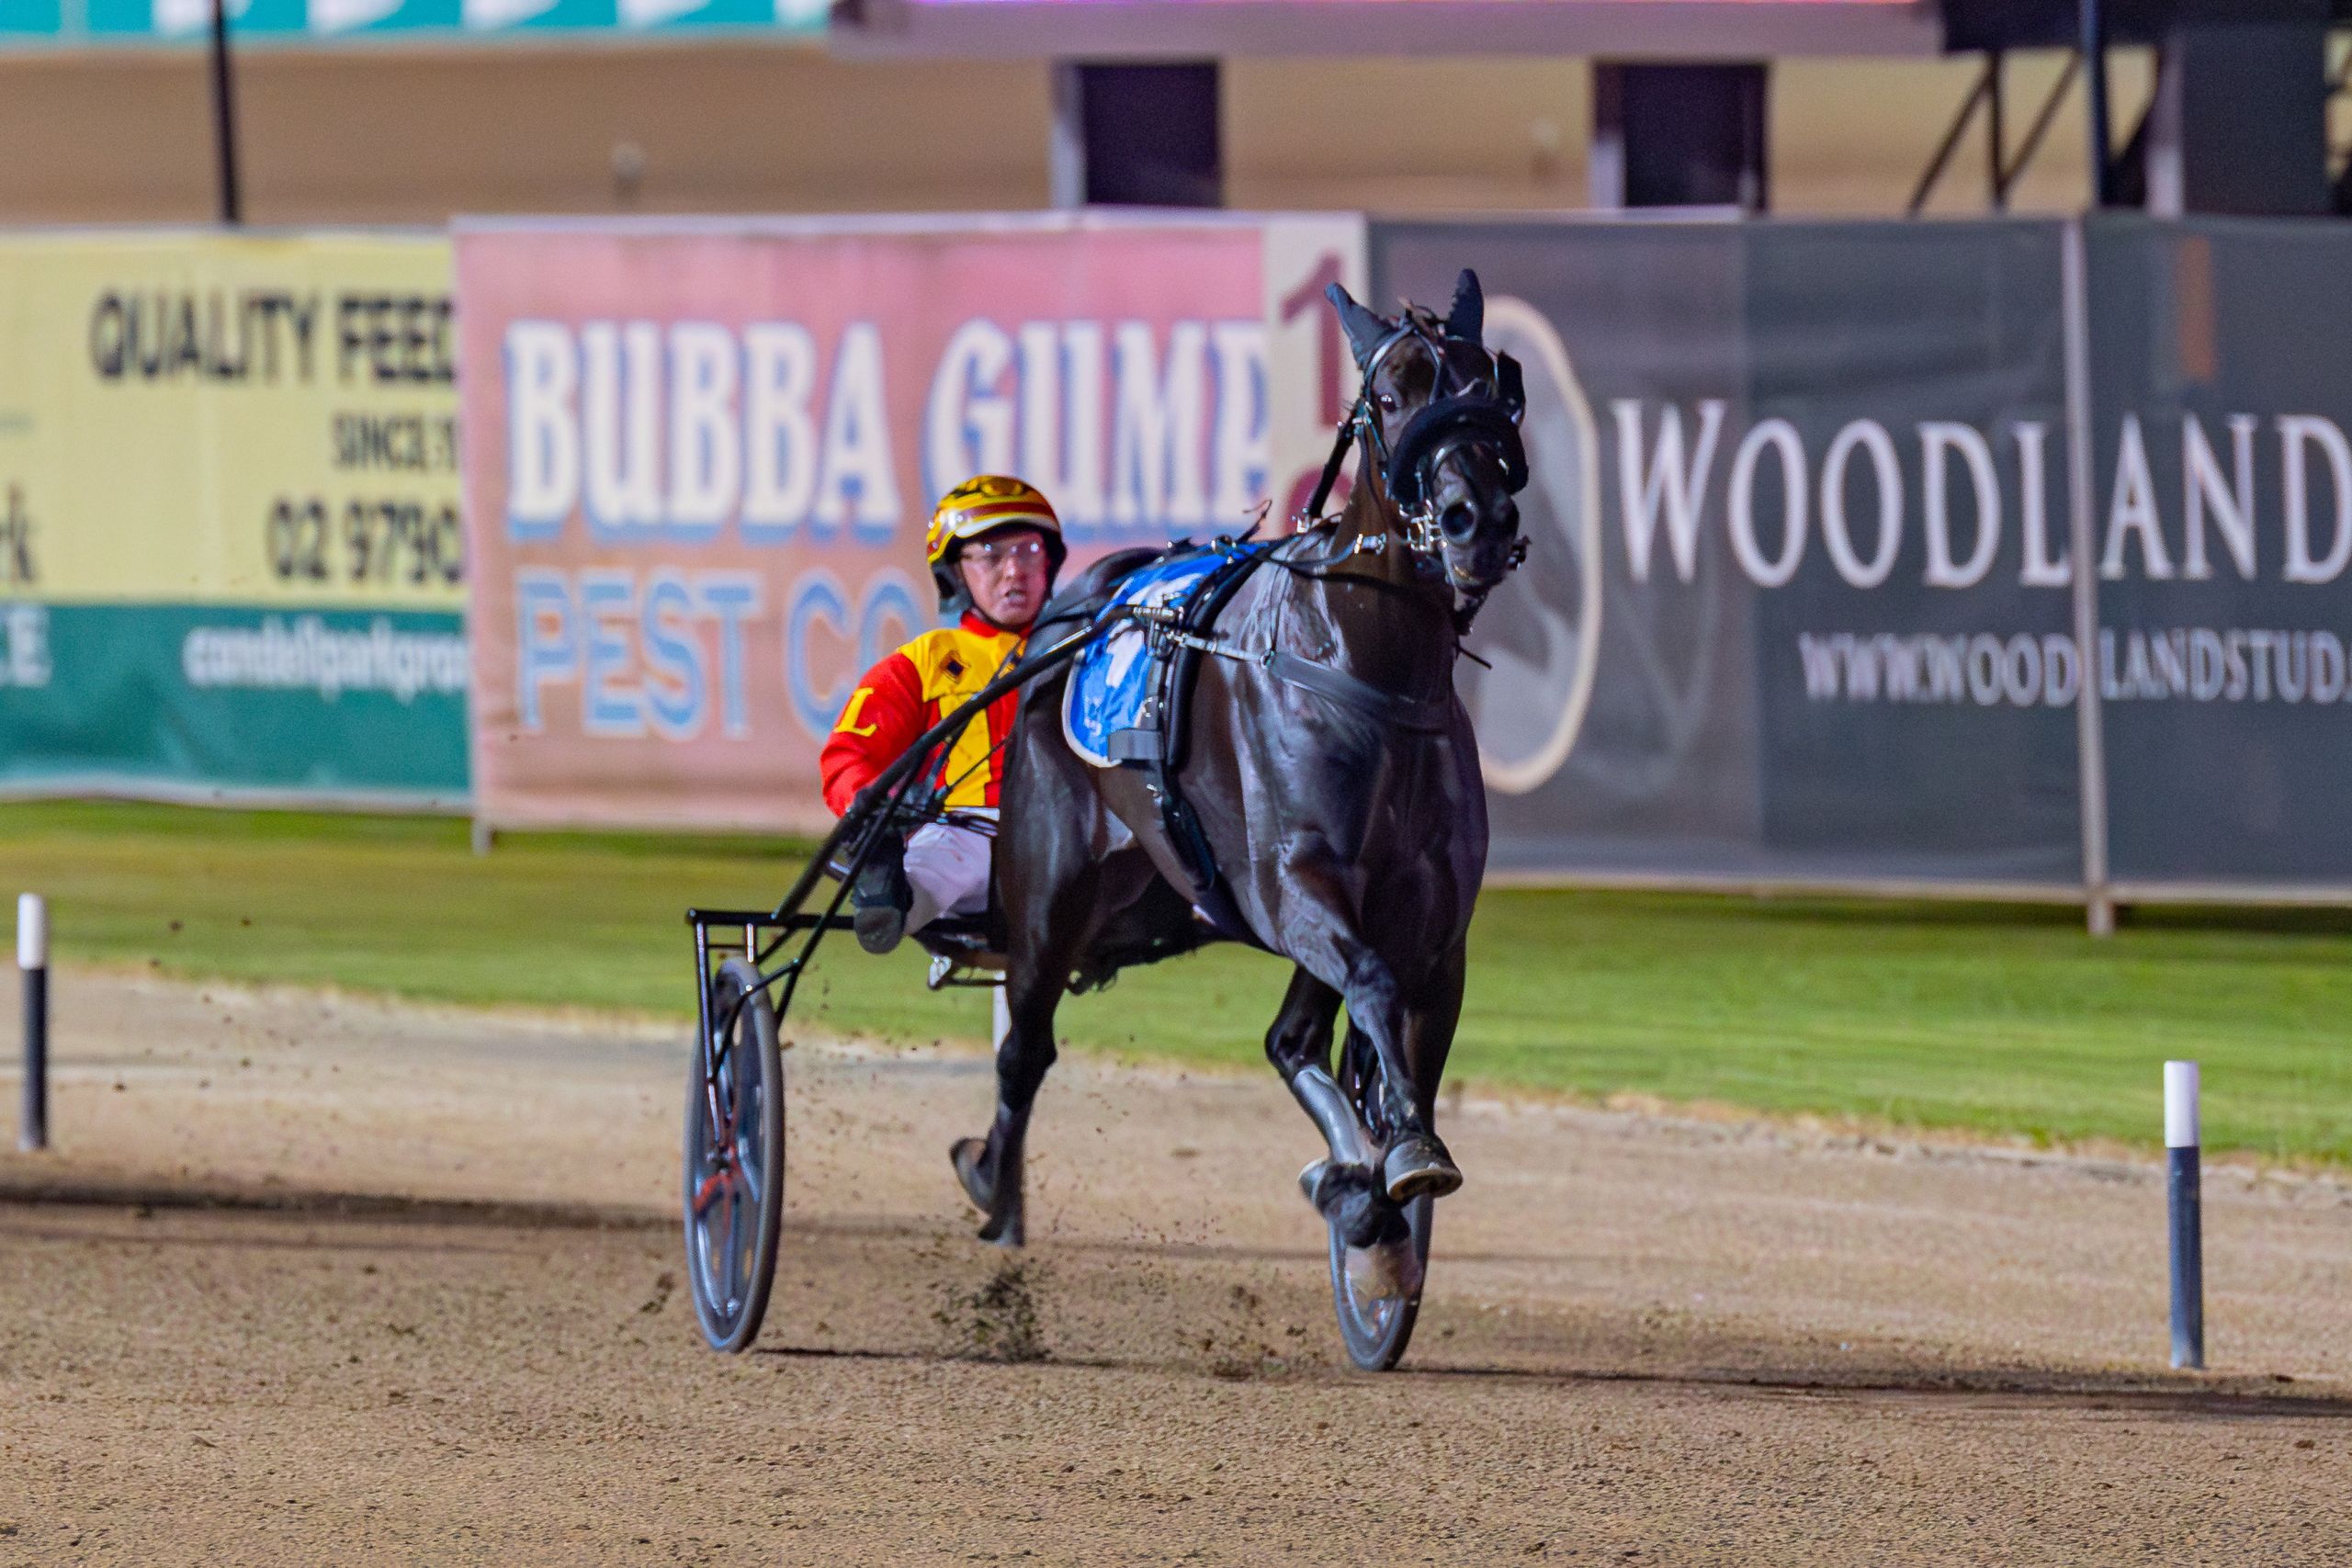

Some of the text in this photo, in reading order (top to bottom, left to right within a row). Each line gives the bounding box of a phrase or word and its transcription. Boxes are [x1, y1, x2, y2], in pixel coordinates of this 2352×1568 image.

[91, 288, 317, 382] QUALITY
[505, 317, 902, 542] BUBBA
[265, 499, 327, 581] 02
[513, 562, 760, 740] PEST
[832, 686, 878, 738] L
